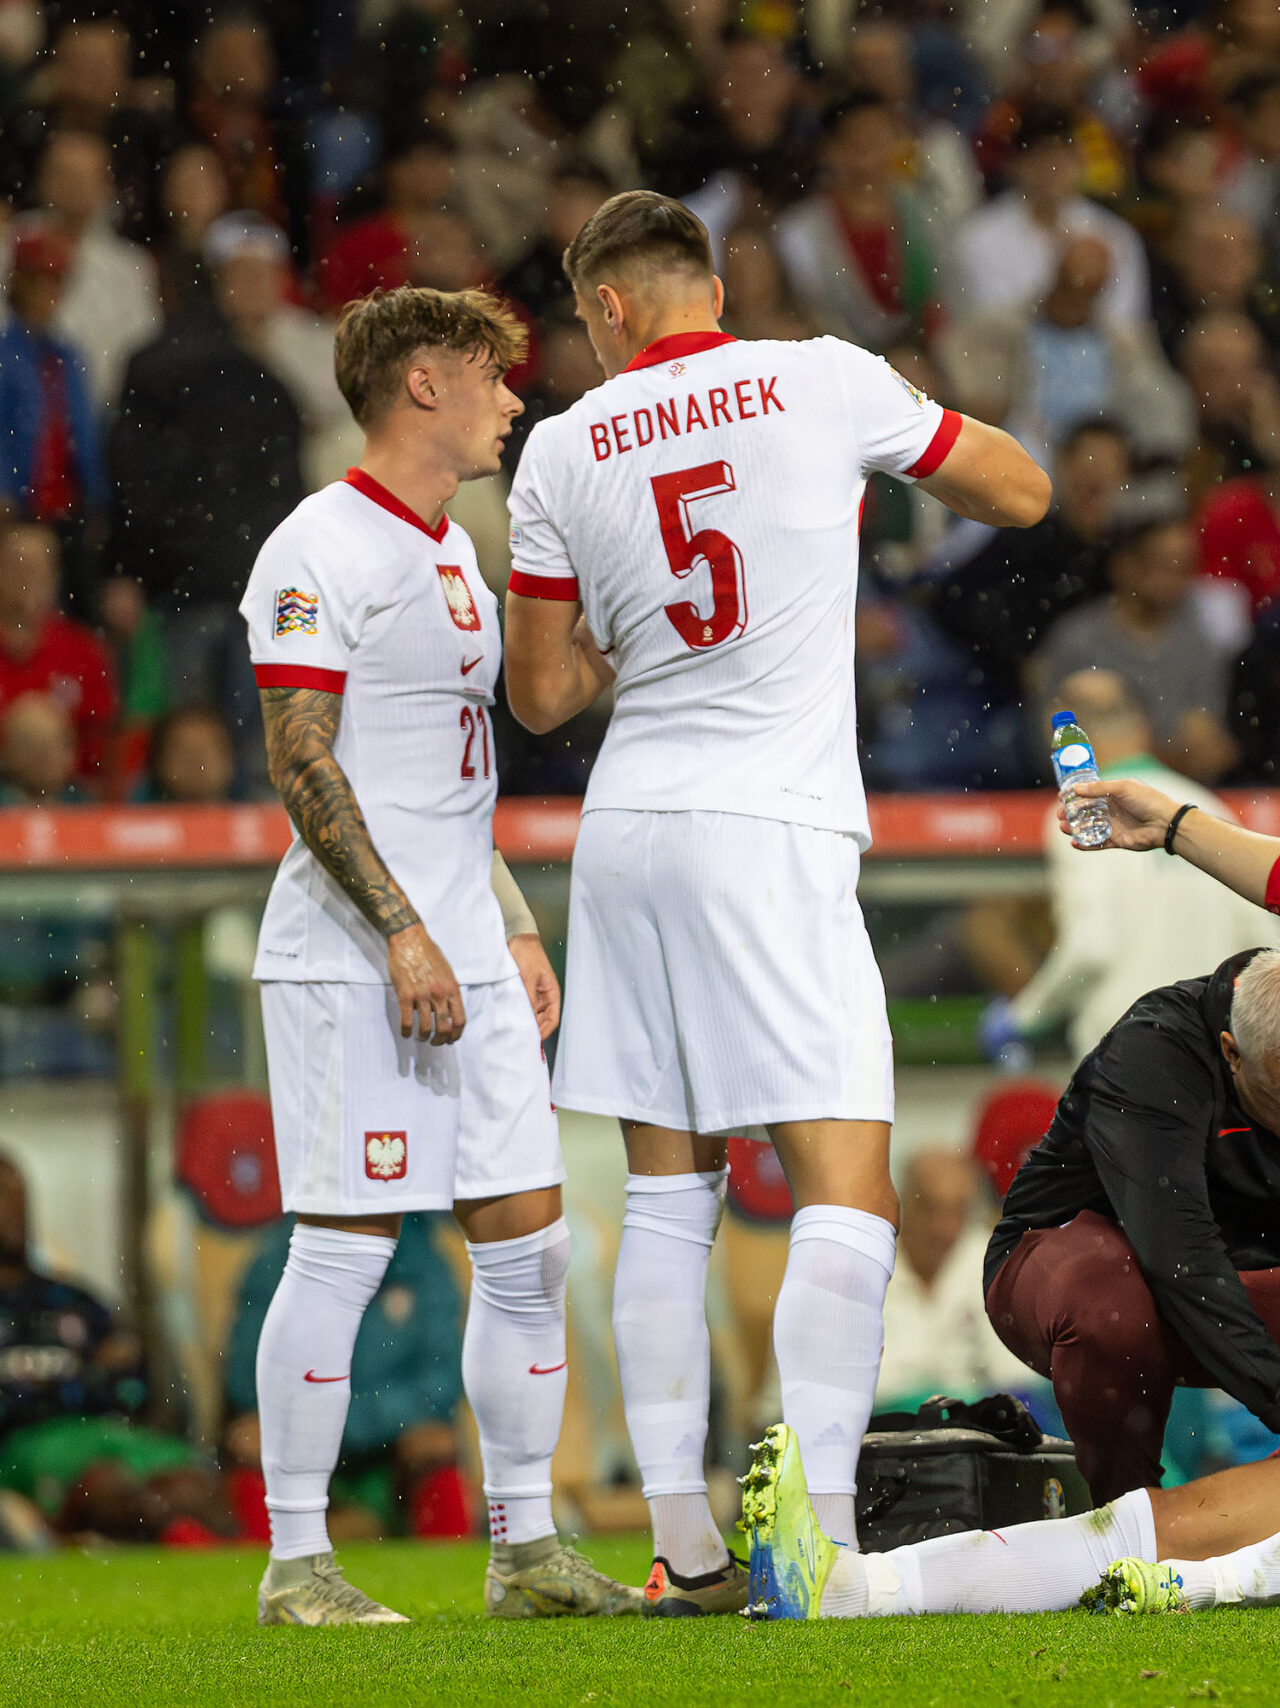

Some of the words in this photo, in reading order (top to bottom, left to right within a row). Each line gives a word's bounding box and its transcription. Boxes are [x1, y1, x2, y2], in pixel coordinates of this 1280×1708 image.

[589, 375, 786, 462] BEDNAREK
[650, 460, 748, 651] 5
[460, 705, 490, 781] 21
